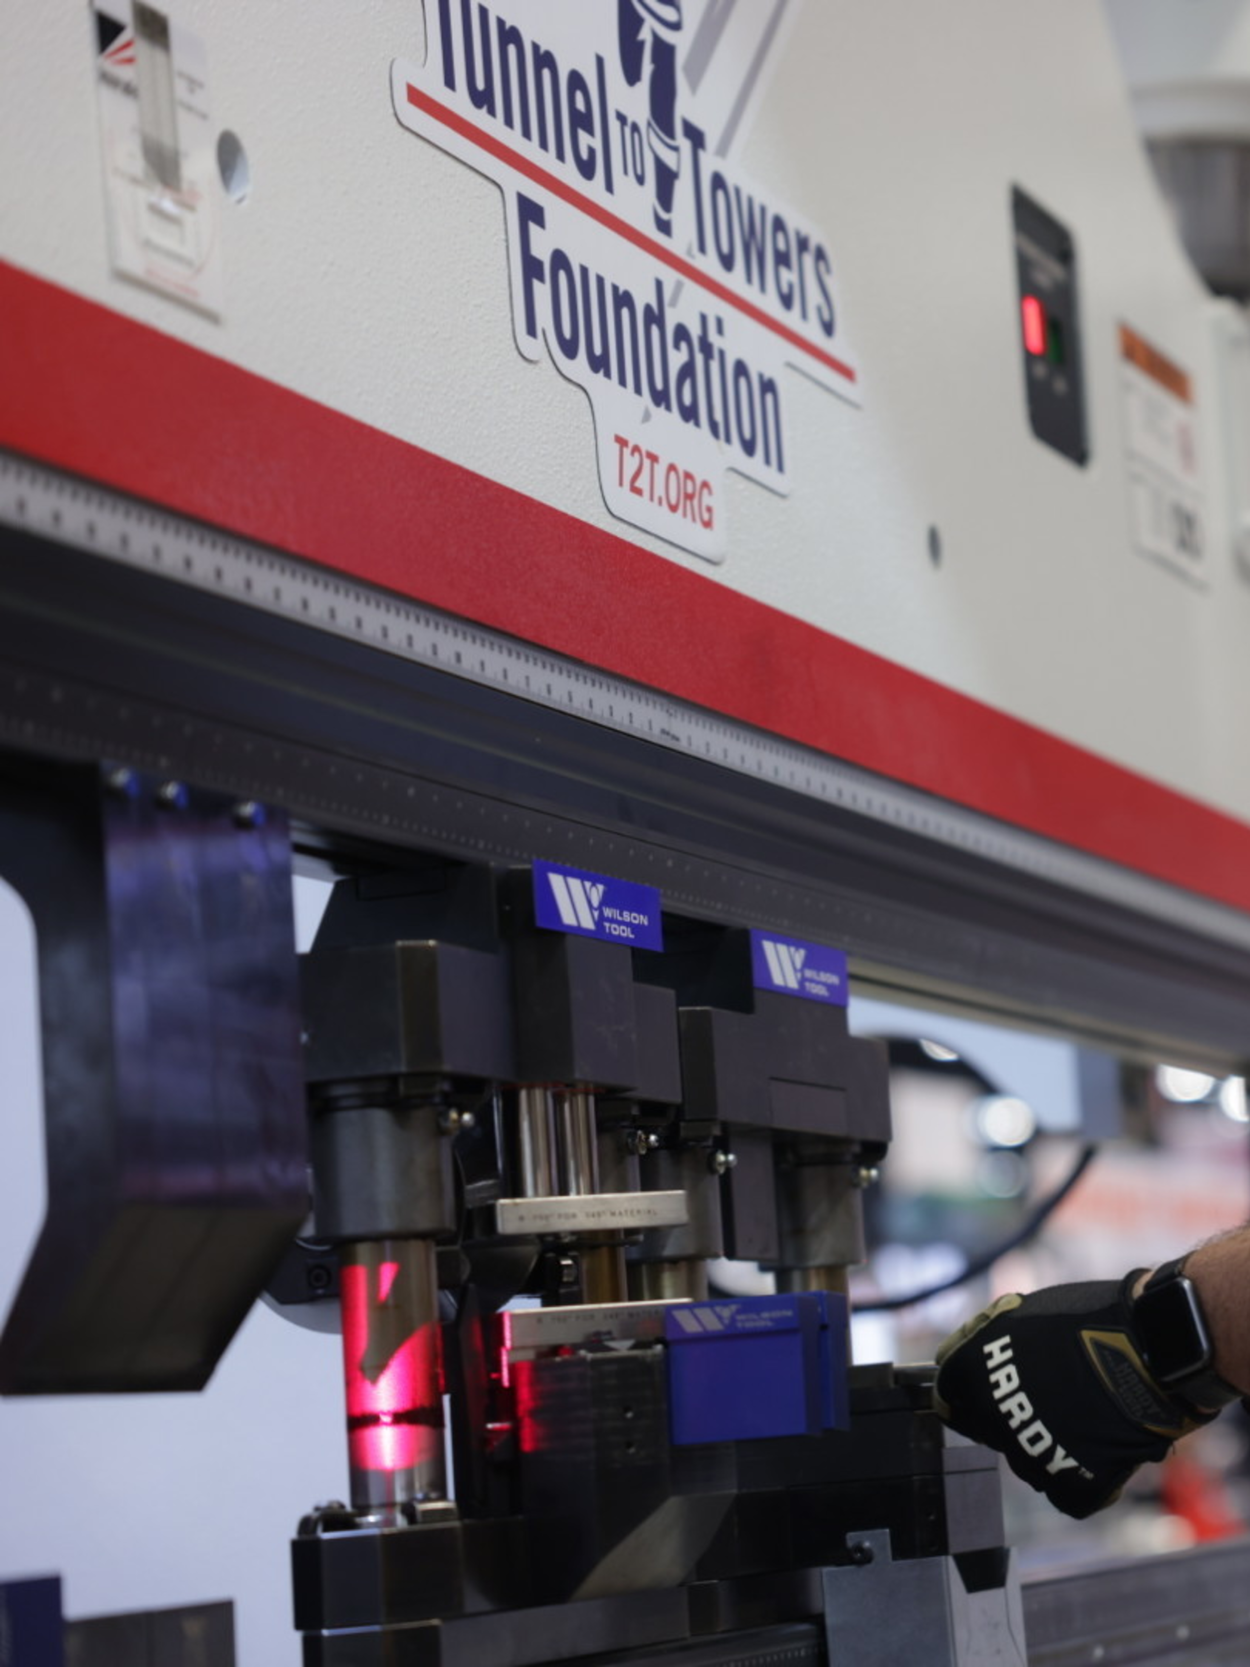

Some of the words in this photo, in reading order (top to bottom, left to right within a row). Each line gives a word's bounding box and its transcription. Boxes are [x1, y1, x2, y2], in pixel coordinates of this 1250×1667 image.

[615, 109, 646, 187] TO
[681, 116, 836, 339] Towers
[516, 190, 785, 475] Foundation
[613, 433, 714, 531] T2T.ORG
[602, 906, 649, 927] WILSON
[604, 922, 635, 939] TOOL
[804, 967, 840, 987] WILSON
[805, 981, 831, 997] TOOL
